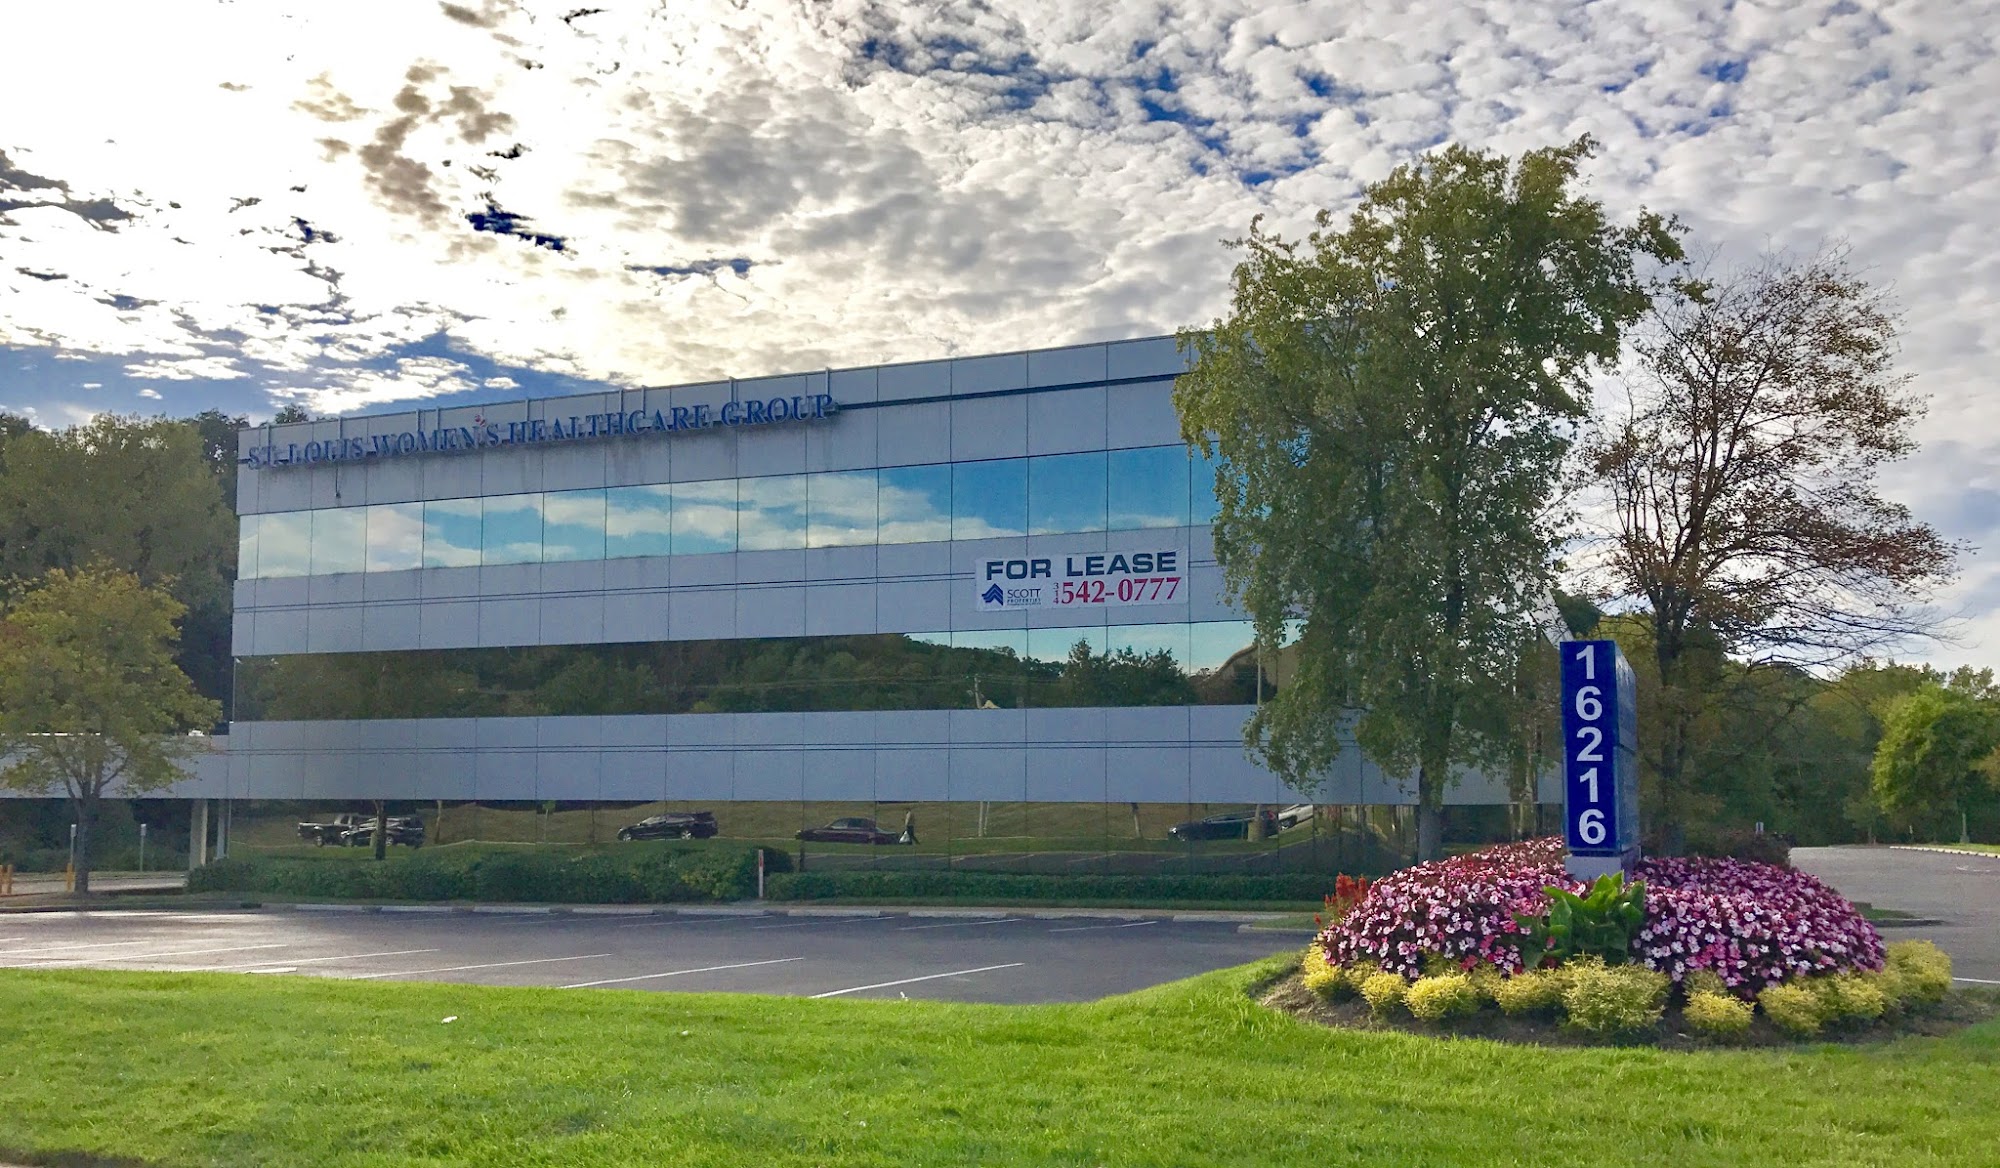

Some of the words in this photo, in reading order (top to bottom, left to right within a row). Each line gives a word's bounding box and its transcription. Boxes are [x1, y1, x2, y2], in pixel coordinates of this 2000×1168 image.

[288, 437, 363, 465] LOUIS
[508, 404, 711, 444] HEALTHCARE
[721, 393, 833, 427] GROUP
[986, 558, 1052, 580] FOR
[1066, 552, 1176, 577] LEASE
[1007, 588, 1042, 598] SCOTT
[1061, 577, 1181, 604] 542-0777
[1575, 645, 1607, 845] 16216
